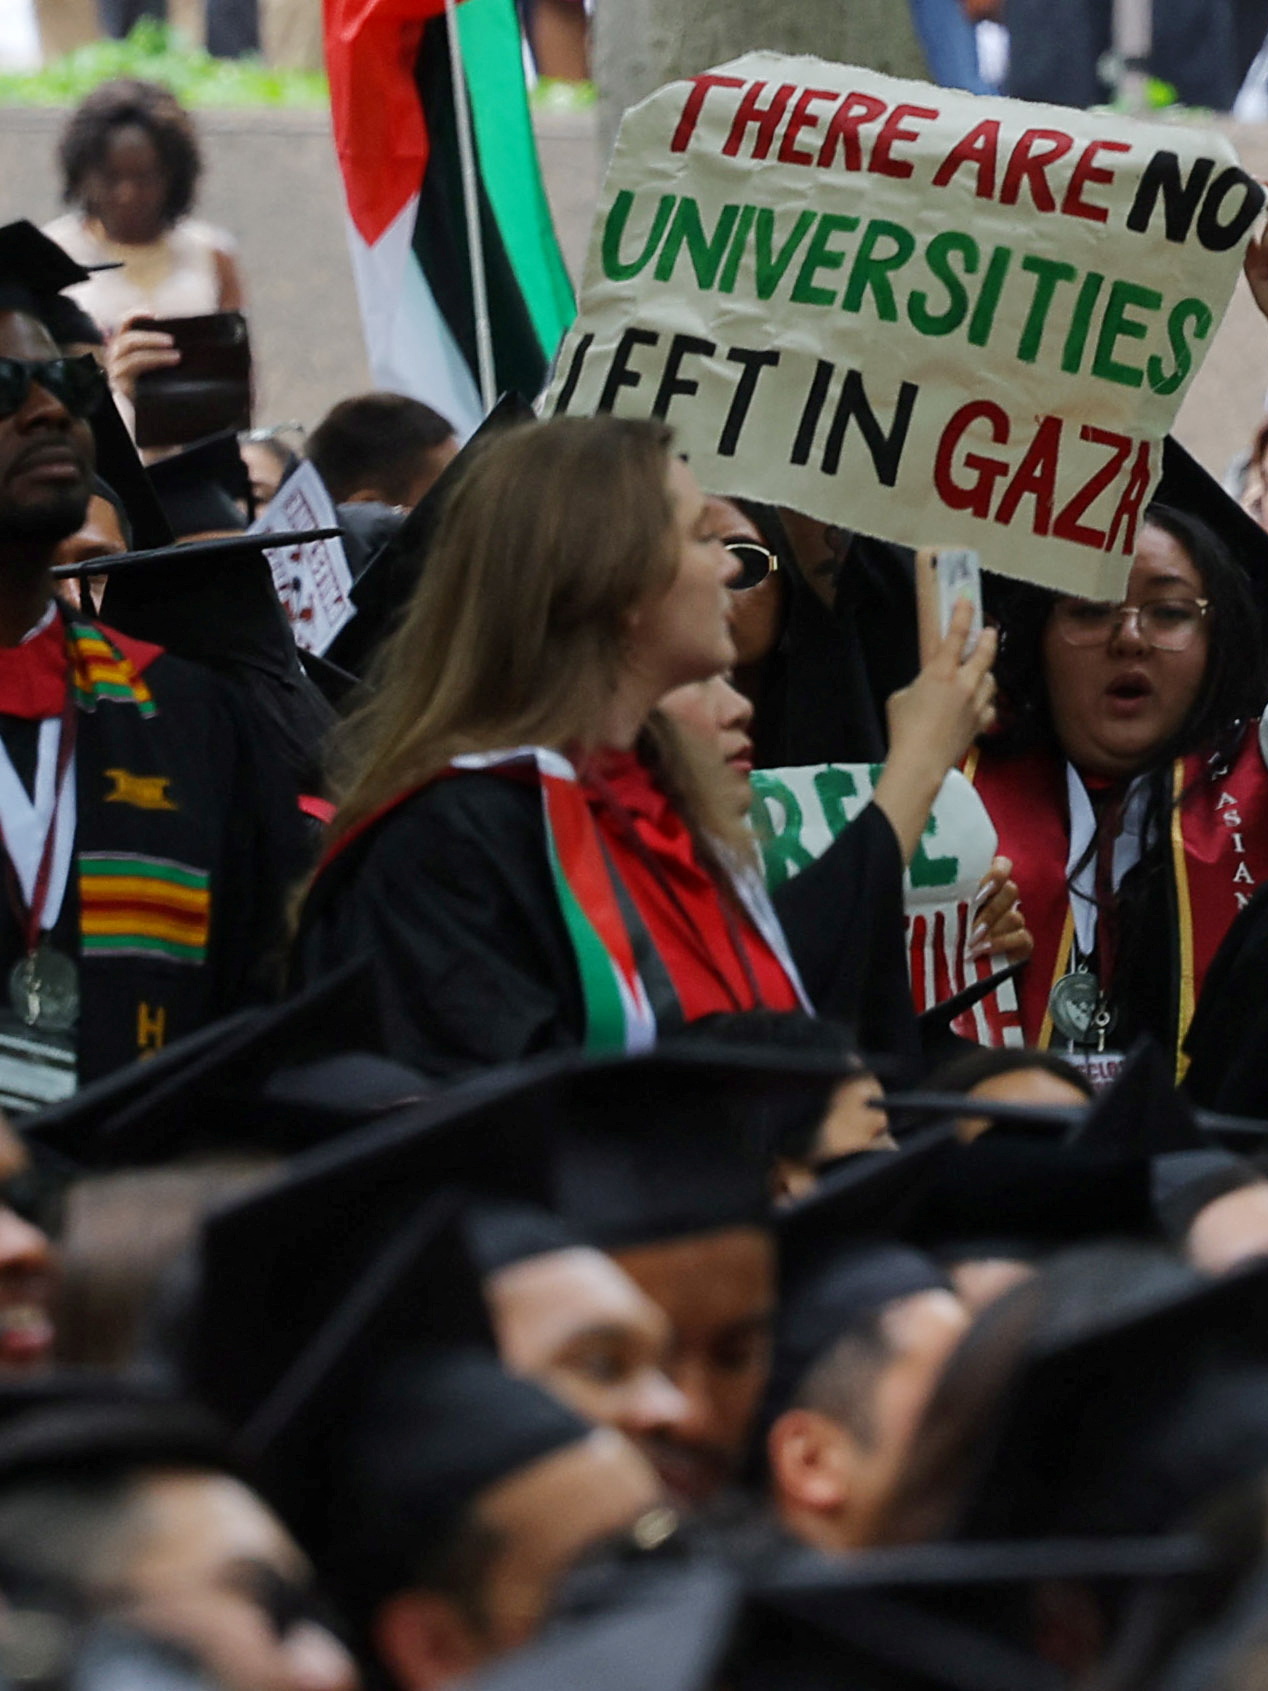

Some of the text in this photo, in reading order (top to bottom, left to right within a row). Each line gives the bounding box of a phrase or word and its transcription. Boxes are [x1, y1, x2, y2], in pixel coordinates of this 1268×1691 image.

[670, 74, 1268, 253] THERE ARE NO
[602, 189, 1213, 396] UNIVERSITIES
[790, 360, 919, 488] IN
[934, 399, 1150, 556] GAZA
